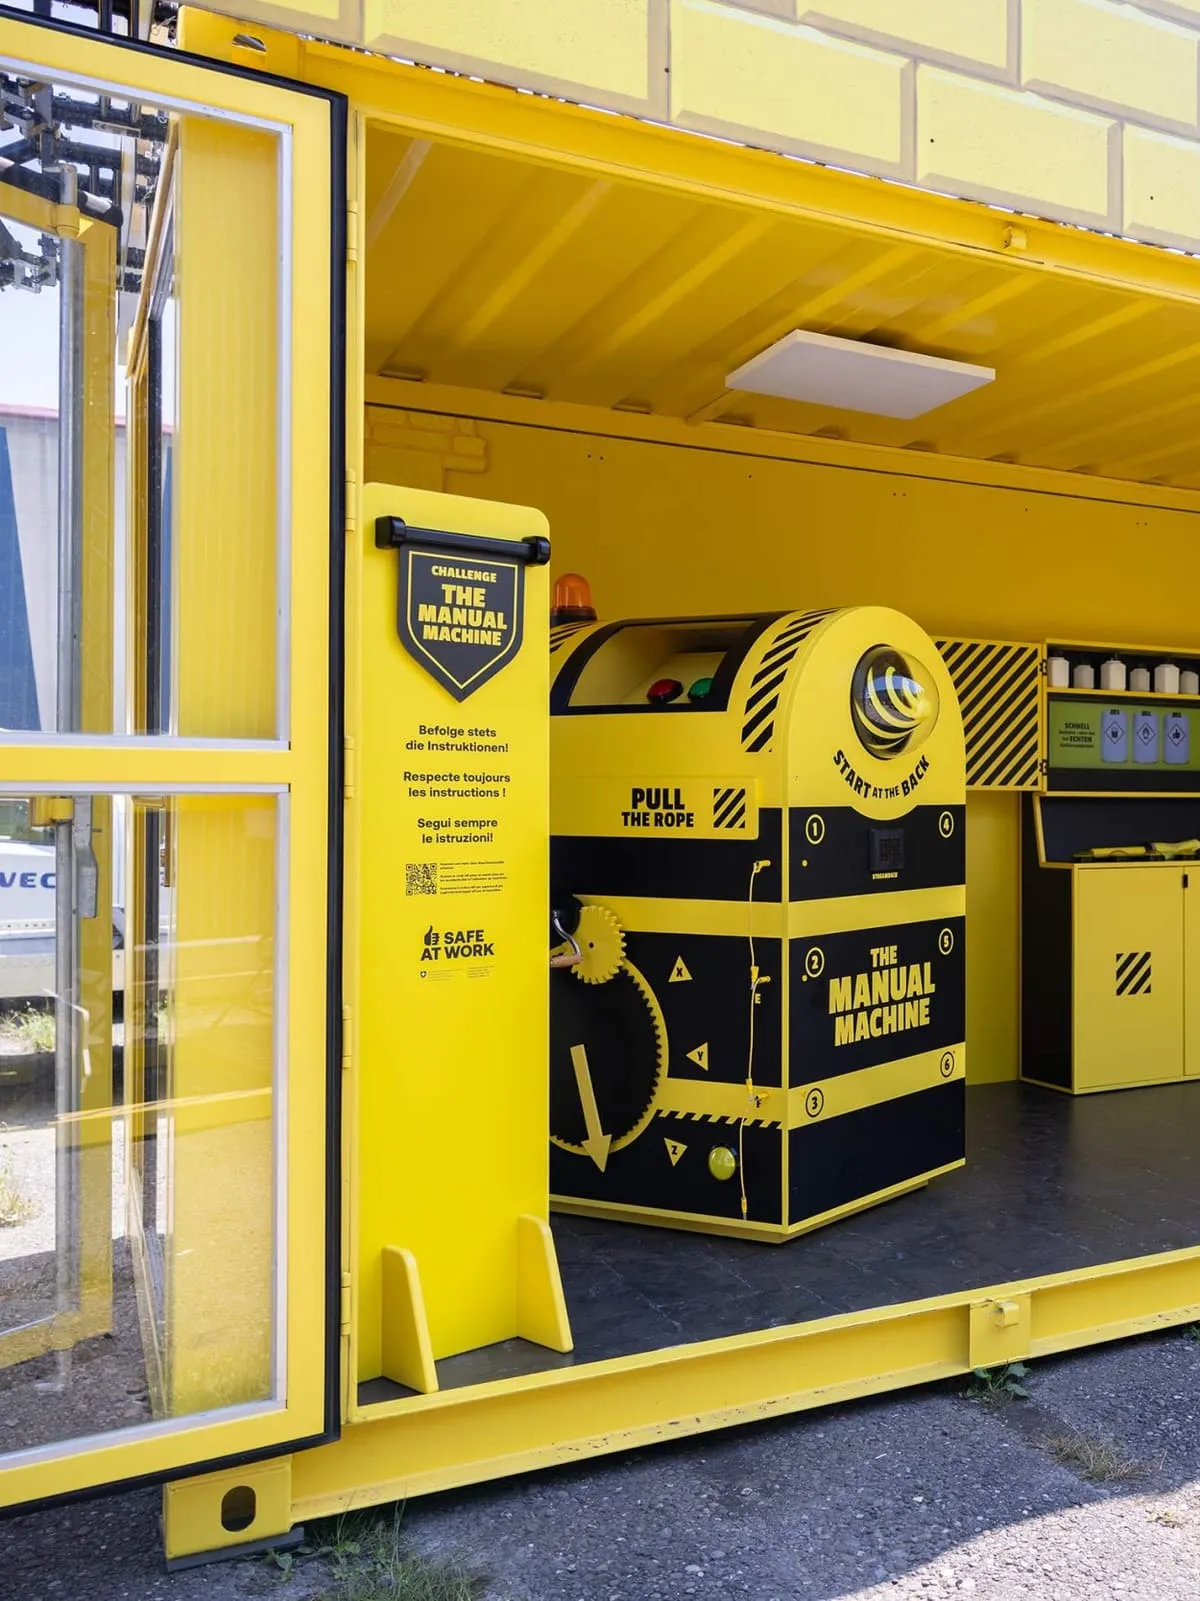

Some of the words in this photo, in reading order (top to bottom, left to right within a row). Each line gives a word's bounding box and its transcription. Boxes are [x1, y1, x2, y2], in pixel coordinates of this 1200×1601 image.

[431, 565, 497, 583] CHALLENGE
[441, 584, 486, 608] THE
[418, 604, 507, 630] MANUAL
[423, 625, 501, 646] MACHINE
[419, 725, 464, 738] Befolge
[467, 728, 497, 737] stets
[405, 740, 424, 750] die
[428, 741, 509, 752] Instruktionen!
[404, 772, 460, 784] Respecte
[463, 772, 511, 784] toujours
[833, 750, 872, 798] START
[872, 787, 882, 799] AT
[885, 786, 900, 799] THE
[901, 755, 930, 797] BACK
[408, 787, 426, 797] les
[430, 787, 499, 798] instructions
[632, 788, 685, 810] PULL
[417, 818, 451, 830] Segui
[454, 819, 498, 829] sempre
[621, 812, 650, 827] THE
[654, 812, 694, 828] ROPE
[422, 834, 432, 843] le
[436, 832, 493, 843] istruzioni!
[0, 872, 56, 888] VEC
[444, 930, 484, 944] SAFE
[420, 947, 441, 961] AT
[445, 943, 494, 959] WORK
[870, 945, 897, 968] THE
[676, 967, 683, 977] X
[829, 962, 935, 1014] MANUAL
[755, 993, 761, 1004] E
[834, 997, 930, 1047] MACHINE
[697, 1051, 704, 1061] Y
[671, 1145, 678, 1155] Z
